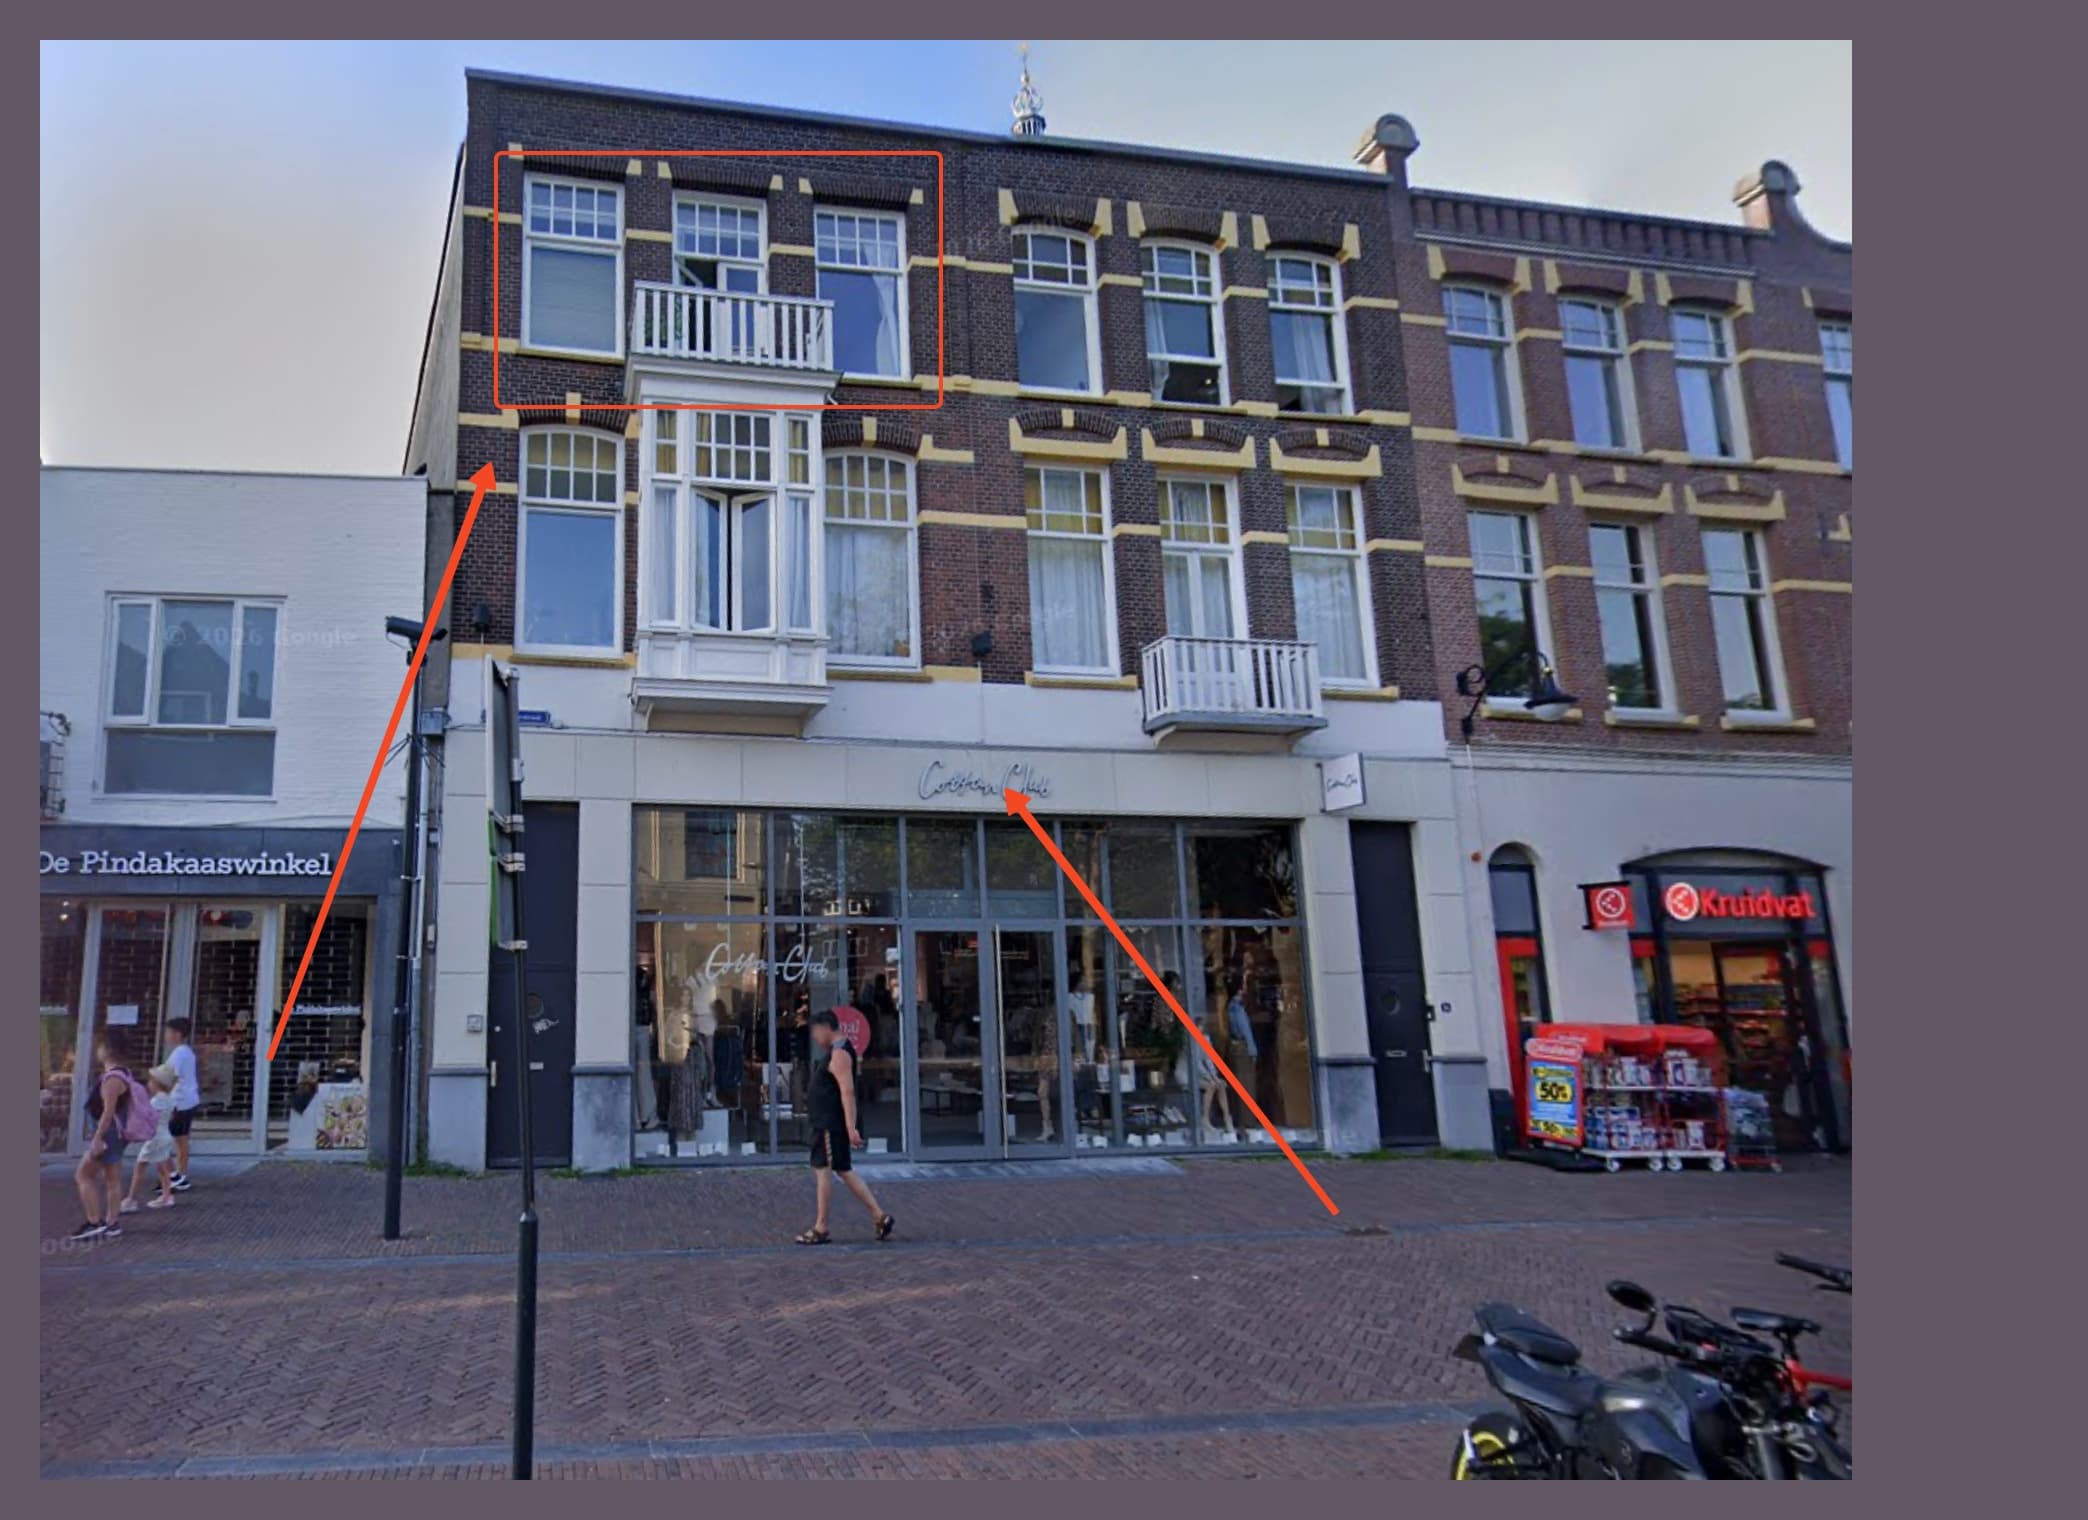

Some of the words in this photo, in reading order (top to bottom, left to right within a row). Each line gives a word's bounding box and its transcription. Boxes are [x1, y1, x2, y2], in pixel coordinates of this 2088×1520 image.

[40, 851, 70, 874] De
[79, 851, 332, 876] Pindakaaswinkel
[1702, 885, 1816, 919] Kruidvat
